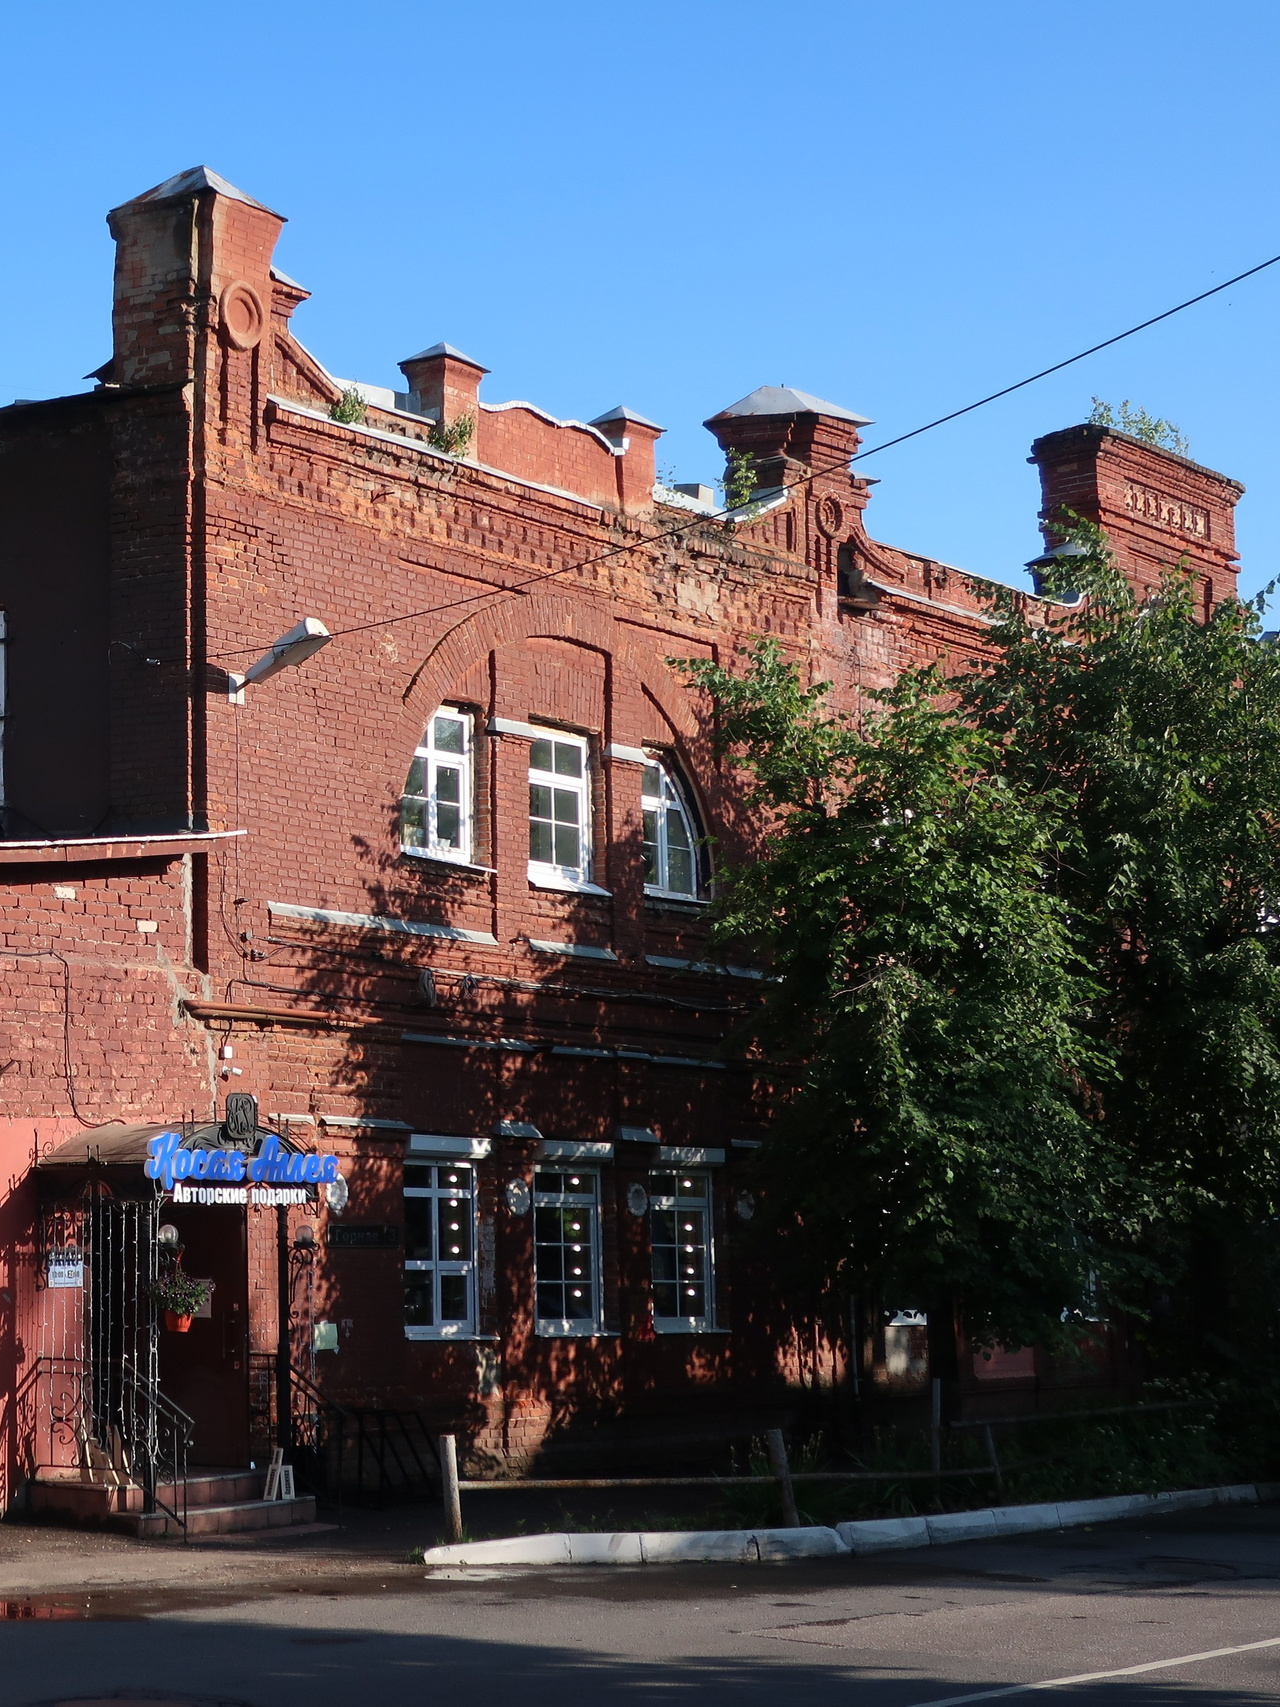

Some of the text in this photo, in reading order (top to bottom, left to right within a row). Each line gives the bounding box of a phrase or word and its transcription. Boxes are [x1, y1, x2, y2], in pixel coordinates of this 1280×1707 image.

[144, 1132, 340, 1190] Косая Аллея
[173, 1183, 307, 1206] Авторские подарки
[335, 1229, 378, 1244] Горная
